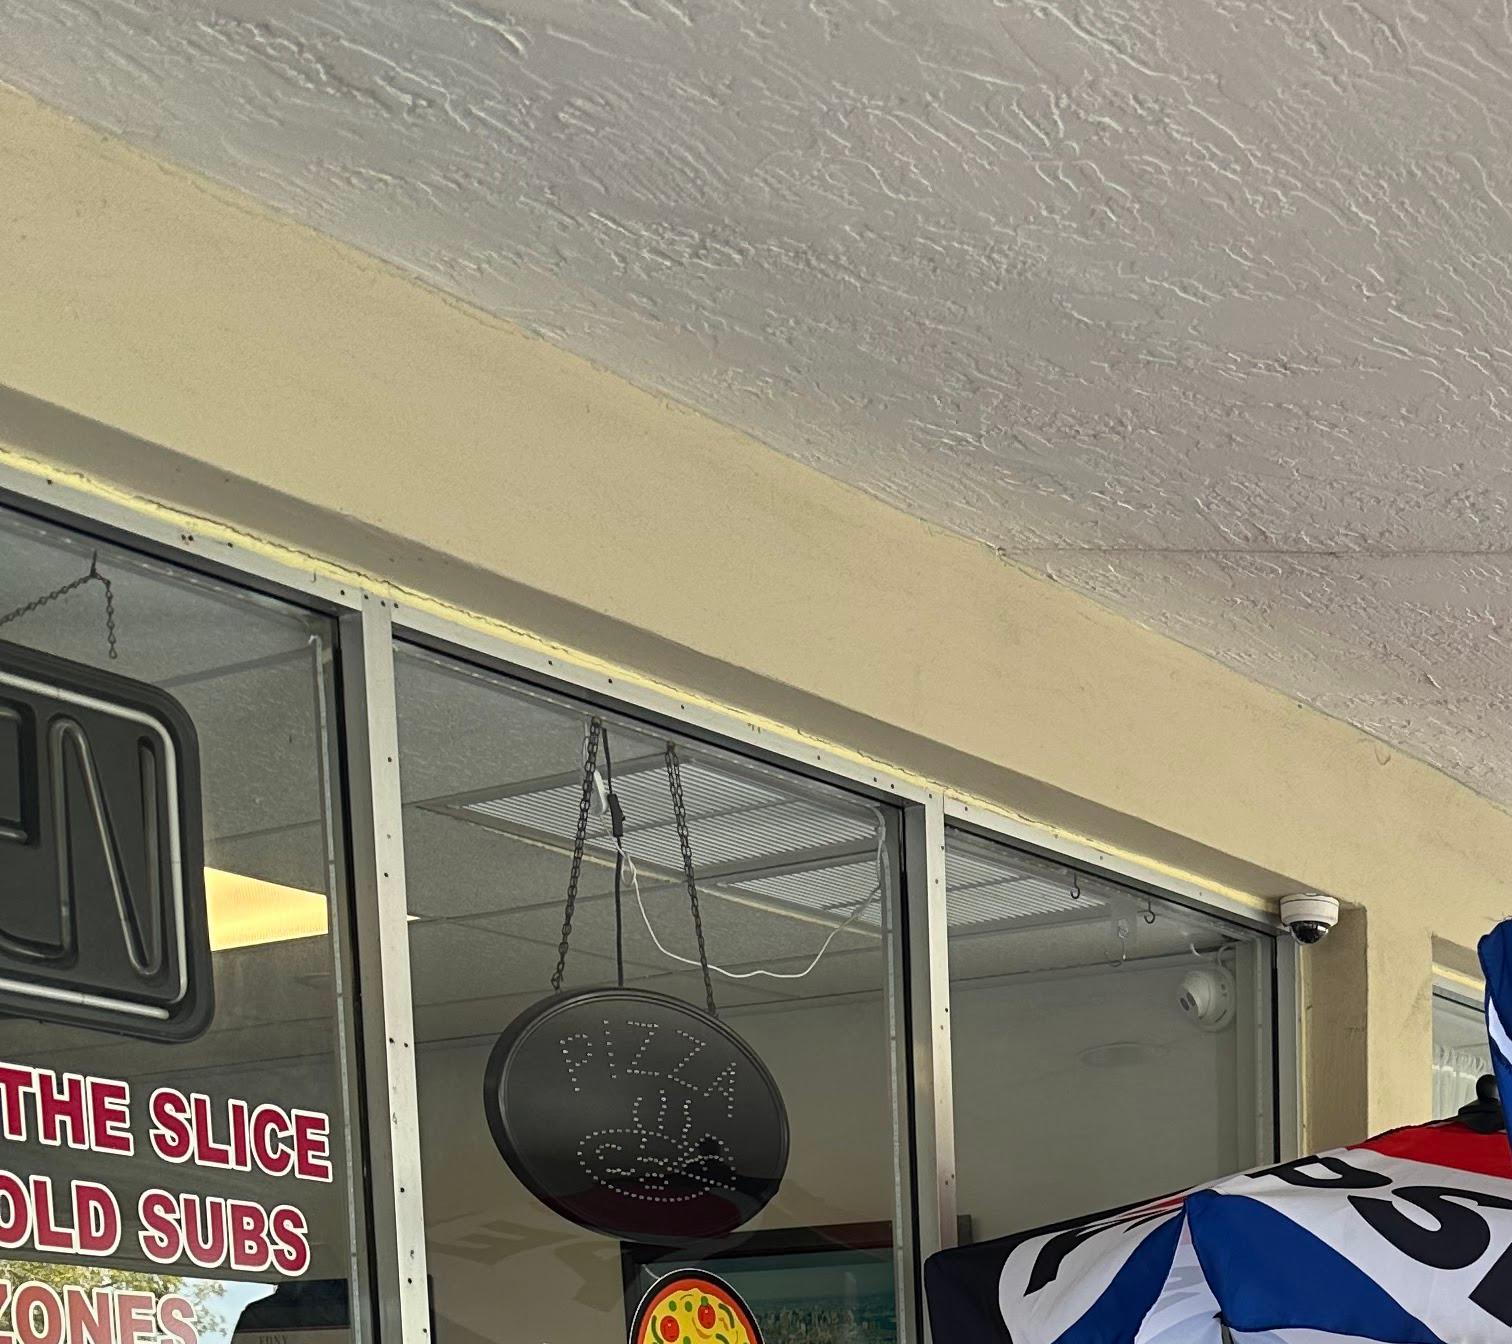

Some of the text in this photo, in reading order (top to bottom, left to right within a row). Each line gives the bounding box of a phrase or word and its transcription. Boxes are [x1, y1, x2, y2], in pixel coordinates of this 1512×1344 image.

[557, 1017, 737, 1120] PIZZA
[0, 1062, 333, 1183] THE SLICE
[138, 1189, 310, 1276] SUBS
